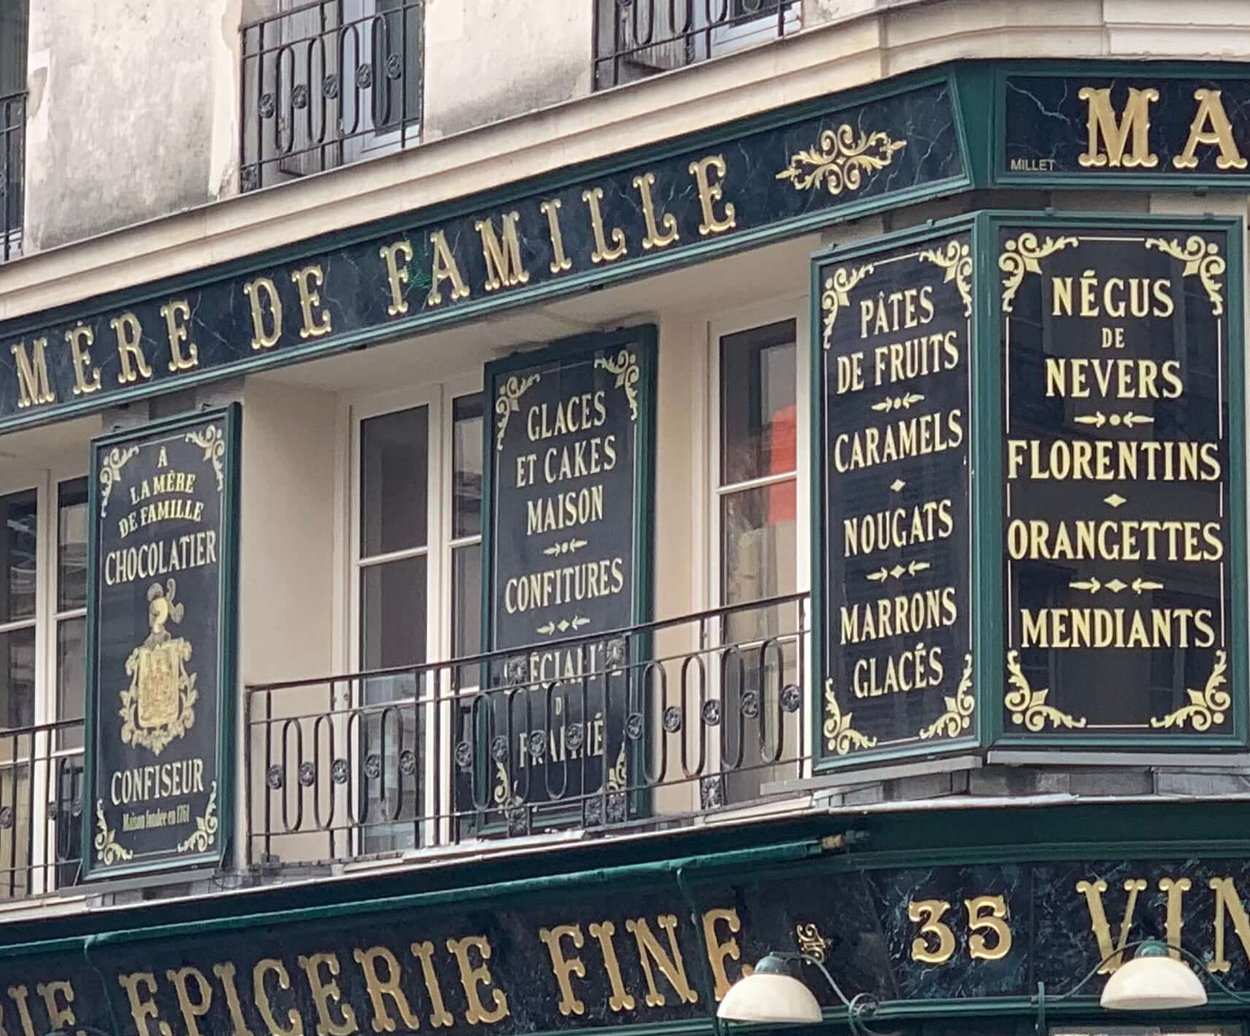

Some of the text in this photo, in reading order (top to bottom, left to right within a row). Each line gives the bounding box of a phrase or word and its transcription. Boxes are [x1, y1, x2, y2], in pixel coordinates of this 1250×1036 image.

[1010, 159, 1055, 172] MILLET
[243, 264, 332, 350] DE
[380, 153, 736, 317] FAMILLE
[860, 285, 934, 338] PÂTES
[1051, 269, 1174, 318] NÉGUS
[836, 330, 959, 395] DE FRUITS
[1101, 327, 1125, 348] DE
[1045, 358, 1184, 398] NEVERS
[526, 389, 607, 443] GLACES
[834, 408, 963, 474] CARAMELS
[515, 434, 617, 488] ET CAKES
[1007, 439, 1221, 481] FLORENTINS
[118, 499, 204, 539] DE FAMILLE
[130, 480, 151, 505] LA
[526, 484, 604, 537] MAISON
[843, 499, 954, 558] NOUGATS
[1007, 519, 1223, 562] ORANGETTES
[105, 530, 216, 586] CHOCOLATIER
[504, 557, 625, 615] CONFITURES
[840, 586, 957, 645] MARRONS
[1020, 608, 1215, 648] MENDIANTS
[853, 642, 943, 699] GLACÉS
[111, 759, 204, 806] CONFISEUR
[908, 894, 1012, 962] 35
[540, 906, 752, 1017] FINE
